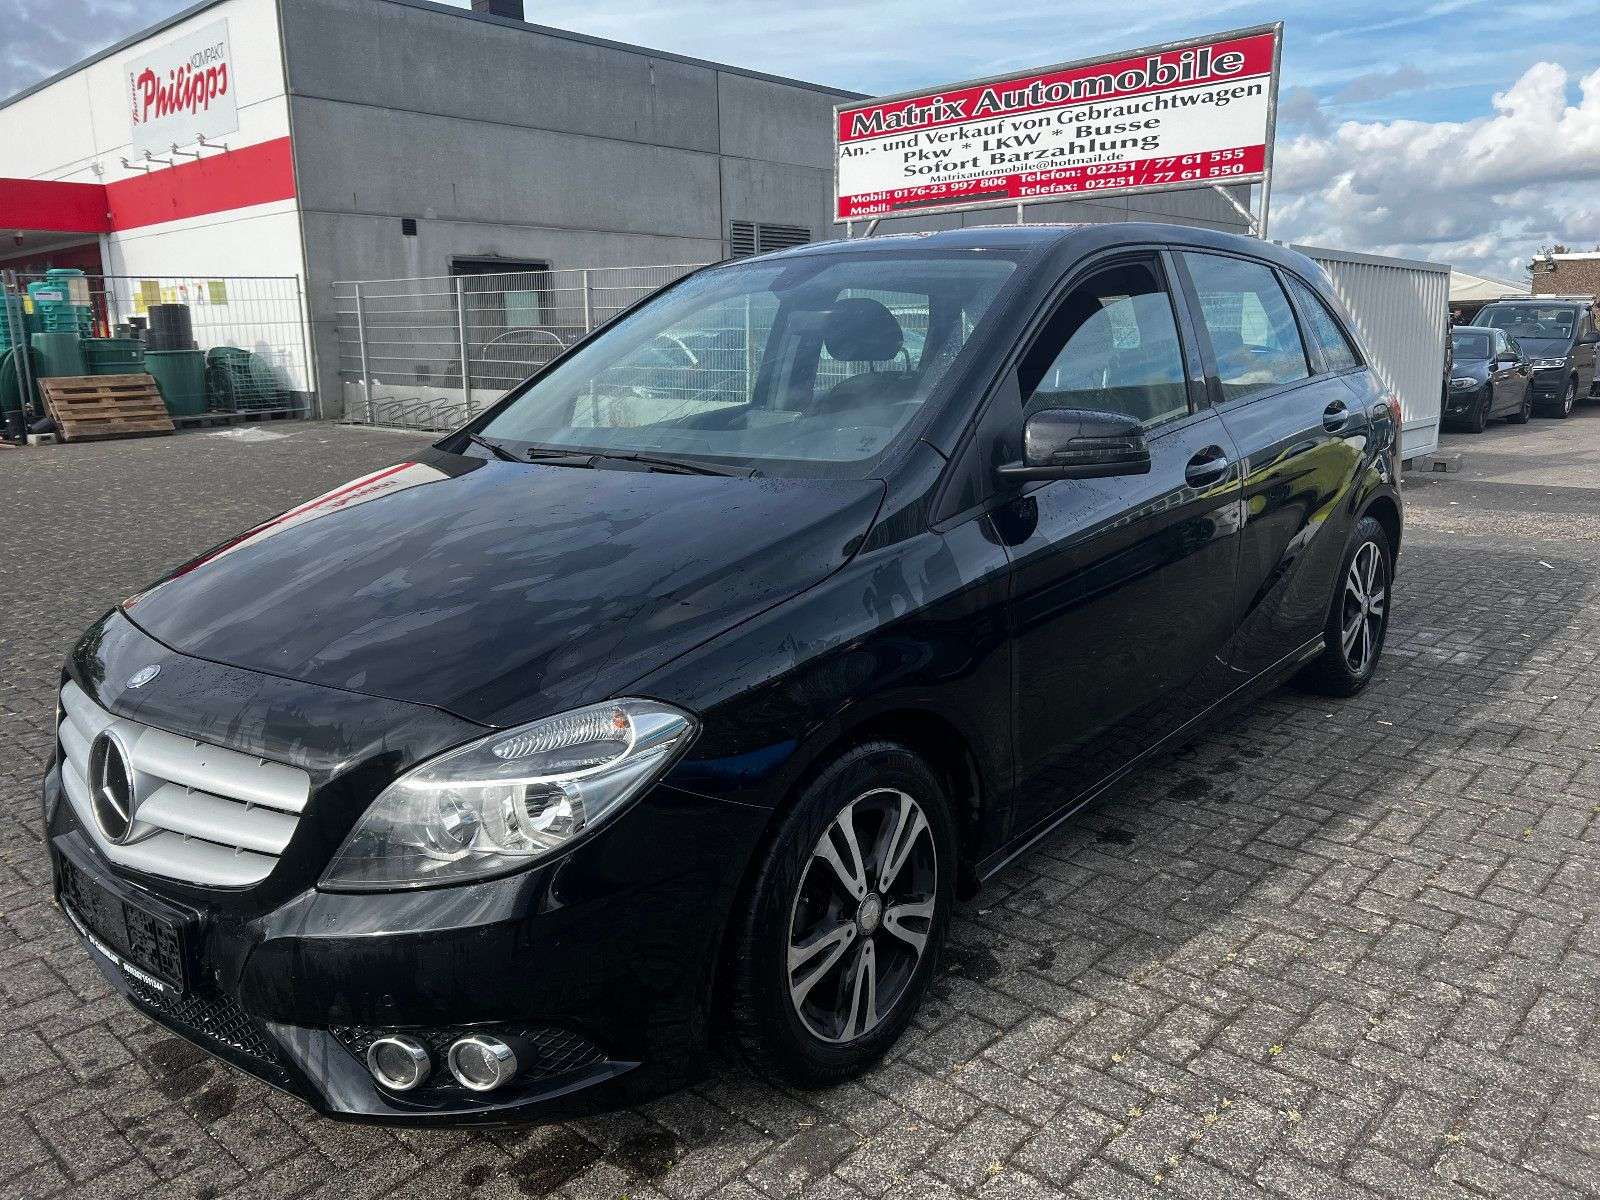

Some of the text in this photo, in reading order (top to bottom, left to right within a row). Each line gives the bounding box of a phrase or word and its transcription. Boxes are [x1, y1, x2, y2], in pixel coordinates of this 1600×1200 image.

[137, 63, 227, 123] Philipps
[851, 46, 1244, 137] Matrix Automobile
[883, 134, 919, 152] und
[925, 120, 1006, 144] Verkauf
[1011, 117, 1051, 132] von
[1057, 83, 1262, 125] Gebrauchtwagen
[904, 117, 1161, 163] Pkw LKW Busse
[904, 133, 1160, 177] Sofort Barzahlung
[930, 152, 1124, 184] Matrixautomobile@hotmail.de
[1019, 182, 1078, 196] Telefax:
[1086, 176, 1134, 189] 02251
[1154, 171, 1173, 182] 77
[1181, 168, 1200, 180] 61
[1209, 164, 1244, 176] 550
[1020, 168, 1081, 184] Telefon:
[1087, 162, 1136, 176] 02251
[1155, 158, 1174, 169] 77
[1182, 154, 1201, 166] 61
[1210, 149, 1245, 162] 555
[850, 192, 890, 204] Mobil:
[894, 184, 946, 198] 0176-23
[951, 180, 976, 191] 997
[980, 176, 1007, 188] 806
[850, 204, 890, 216] Mobil:
